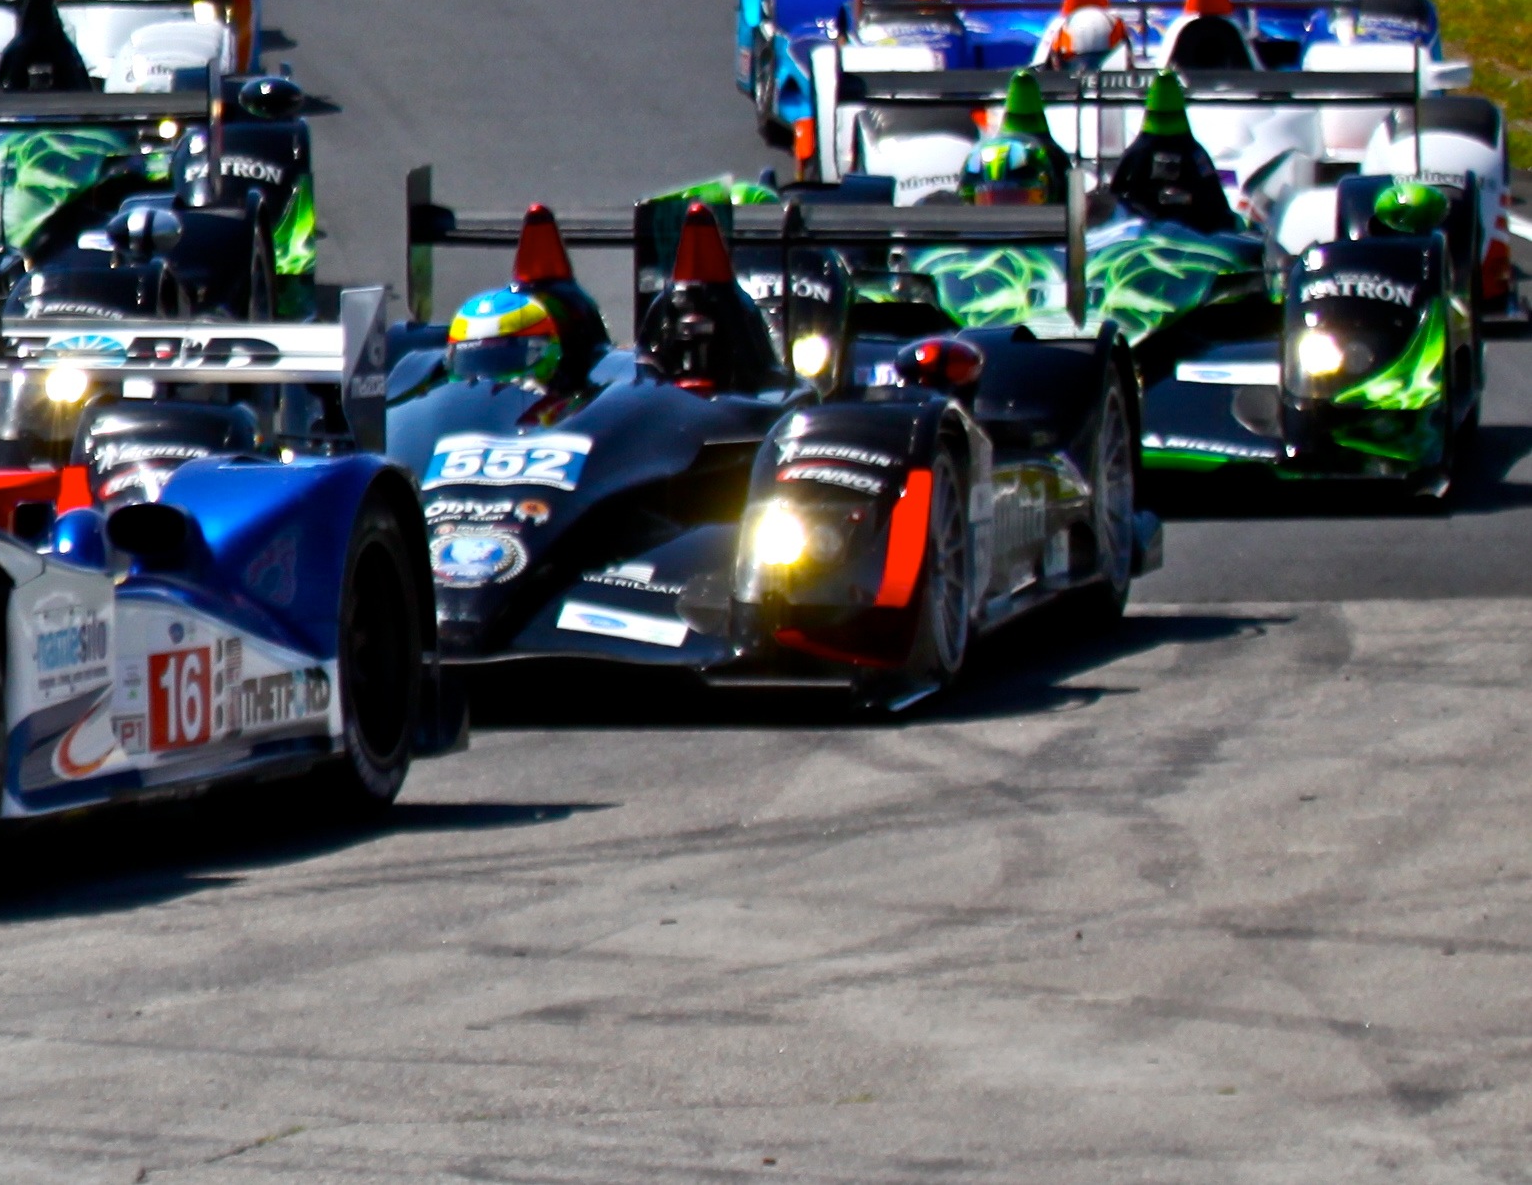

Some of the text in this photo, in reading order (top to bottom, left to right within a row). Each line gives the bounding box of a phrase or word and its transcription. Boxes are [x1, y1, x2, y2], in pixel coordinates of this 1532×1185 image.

[43, 304, 124, 321] MICHELIN
[440, 448, 572, 481] 552
[799, 445, 892, 467] MICHELIN
[785, 467, 884, 495] KENNOL
[160, 653, 203, 744] 16
[120, 716, 146, 748] P1
